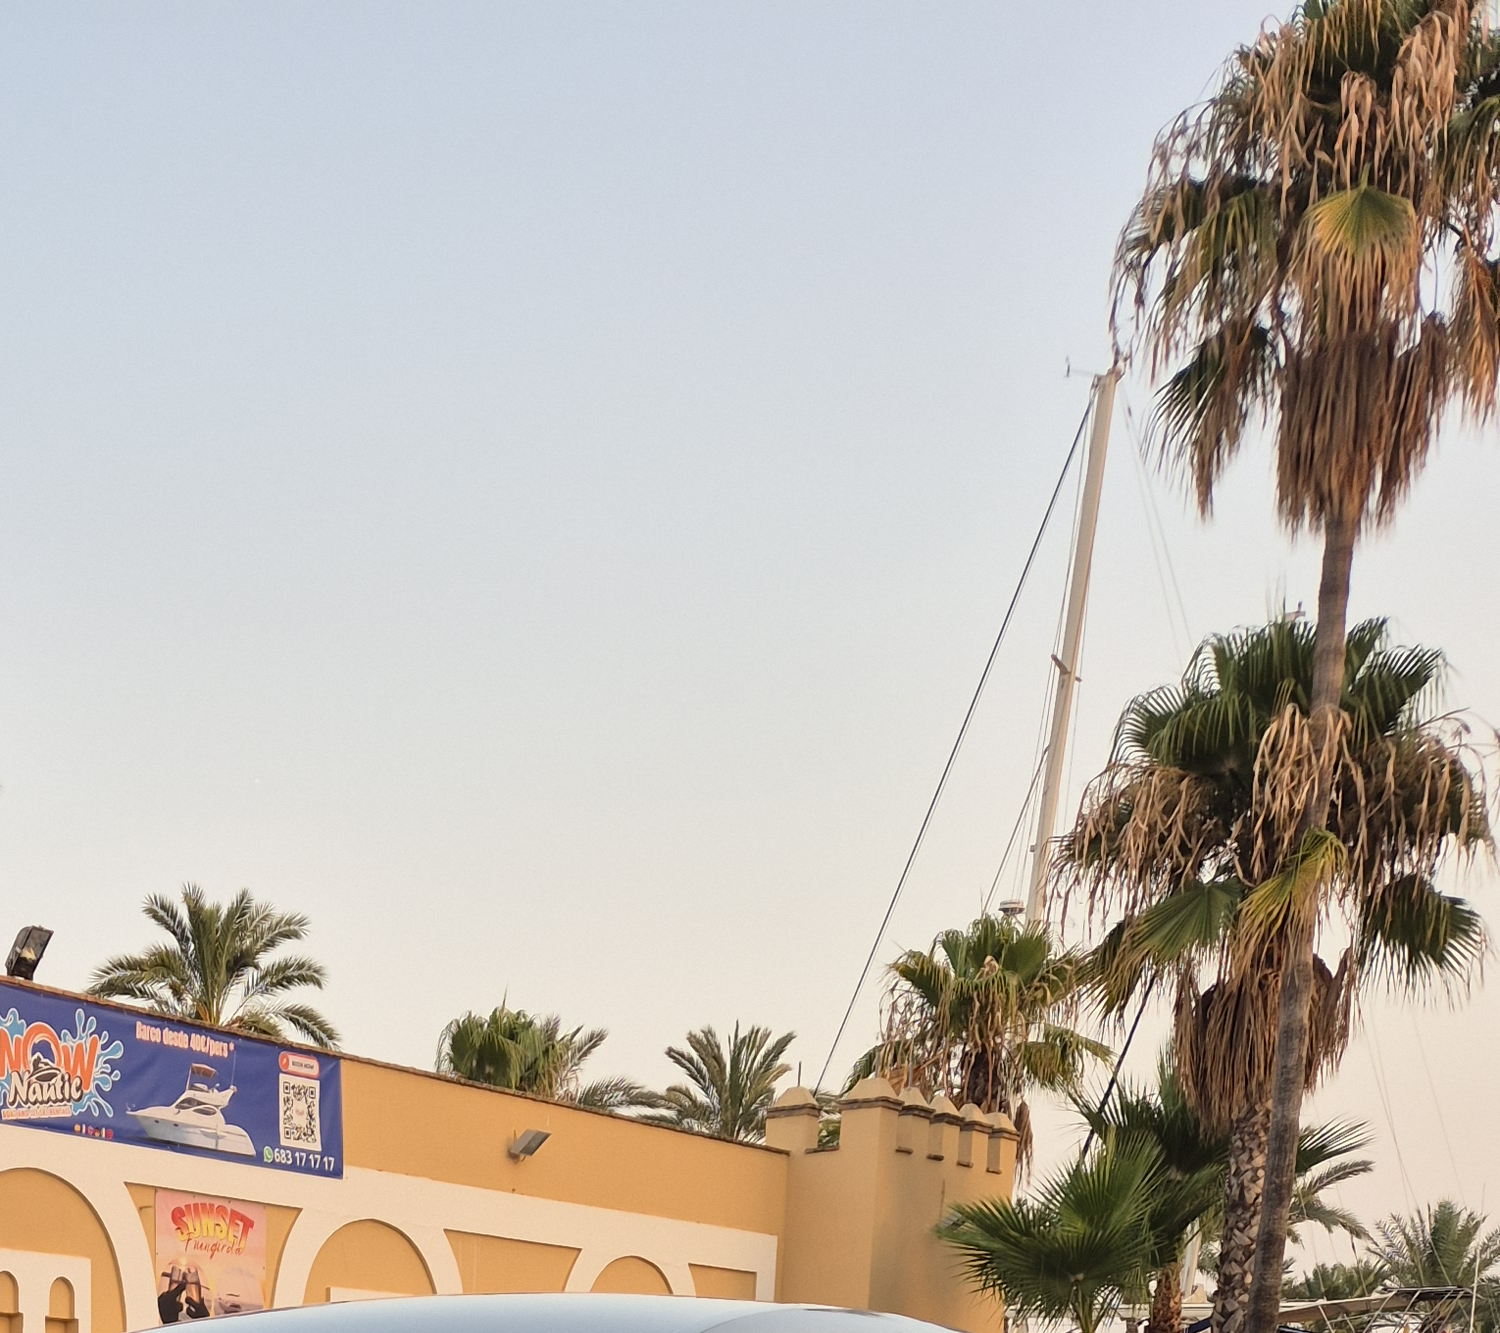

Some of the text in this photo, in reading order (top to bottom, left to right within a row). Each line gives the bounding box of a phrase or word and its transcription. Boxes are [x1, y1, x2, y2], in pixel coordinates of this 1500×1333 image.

[135, 1020, 161, 1043] Barco
[163, 1027, 189, 1049] desde
[8, 1070, 84, 1106] Nautic
[274, 1147, 335, 1171] 683 17 17 17
[171, 1202, 255, 1250] SUNSET
